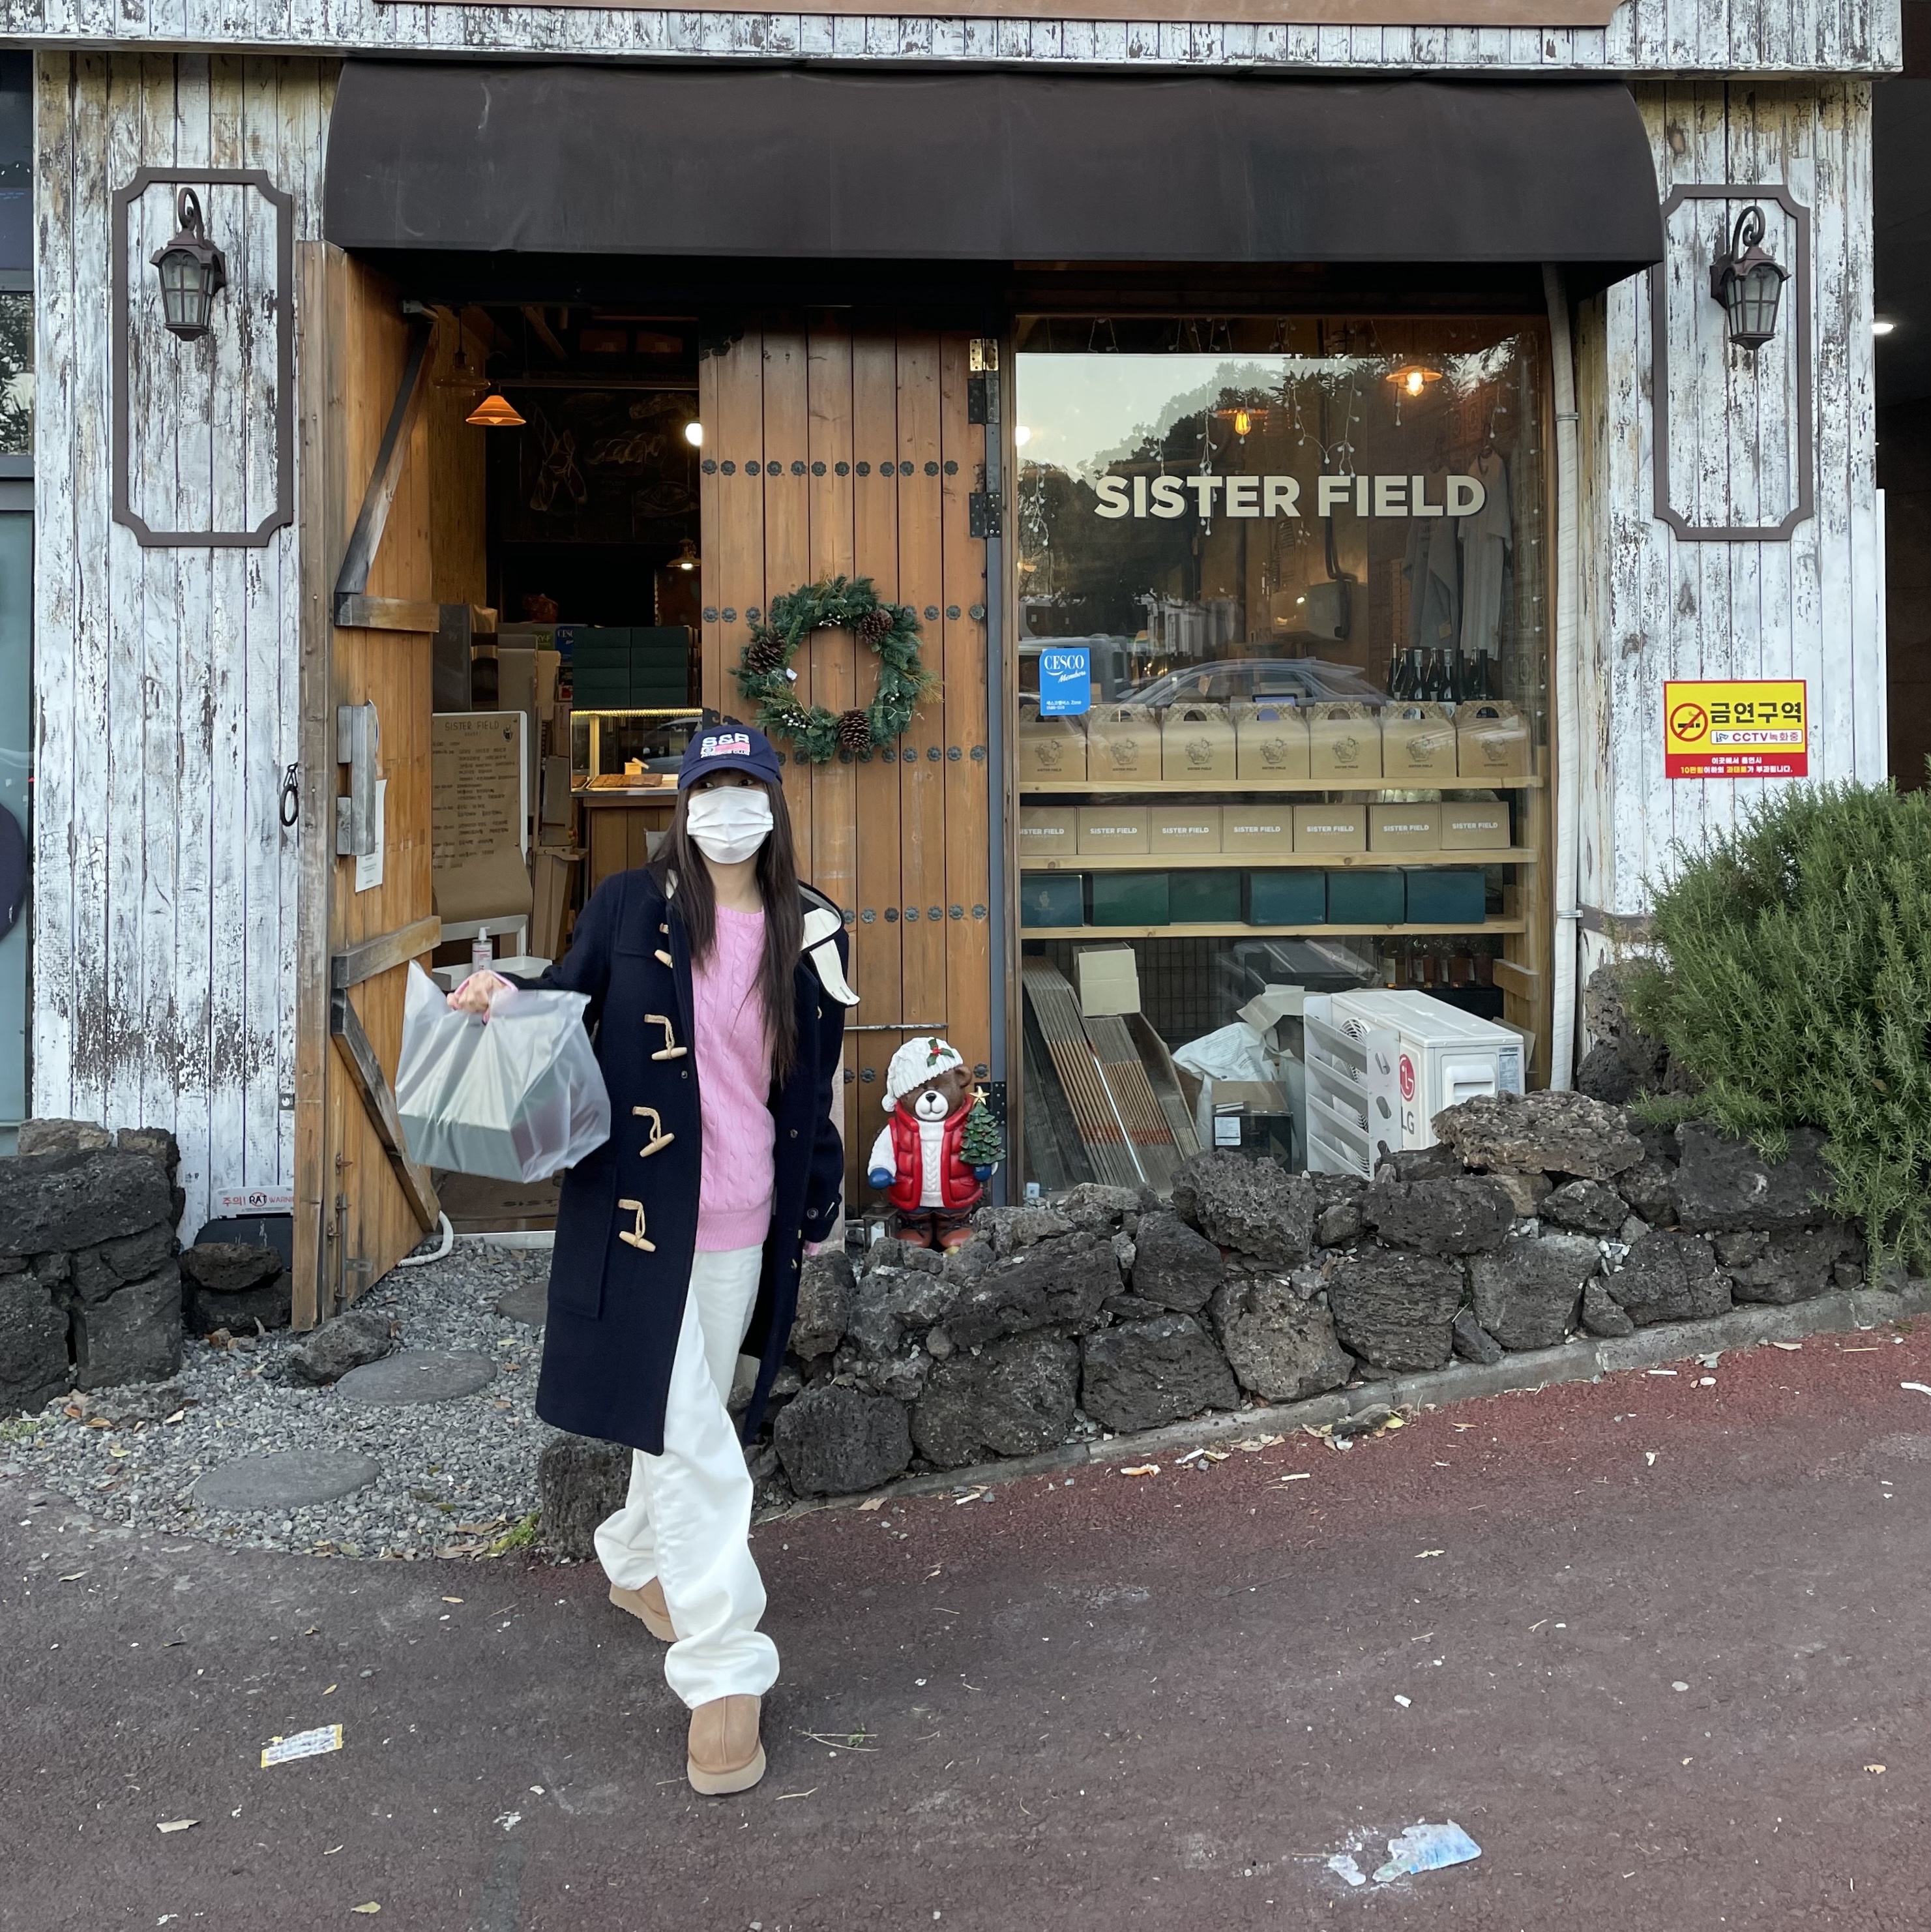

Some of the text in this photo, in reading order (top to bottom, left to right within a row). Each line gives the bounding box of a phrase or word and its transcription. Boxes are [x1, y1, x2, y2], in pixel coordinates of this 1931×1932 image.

[1094, 475, 1486, 518] SISTER FIELD
[1044, 655, 1084, 670] CESCO
[1057, 669, 1086, 683] Members
[1710, 702, 1802, 724] 금연구역
[445, 721, 499, 731] SISTER FIELD
[702, 732, 750, 748] S&R
[1401, 1107, 1415, 1135] LG
[249, 1195, 267, 1206] RAT
